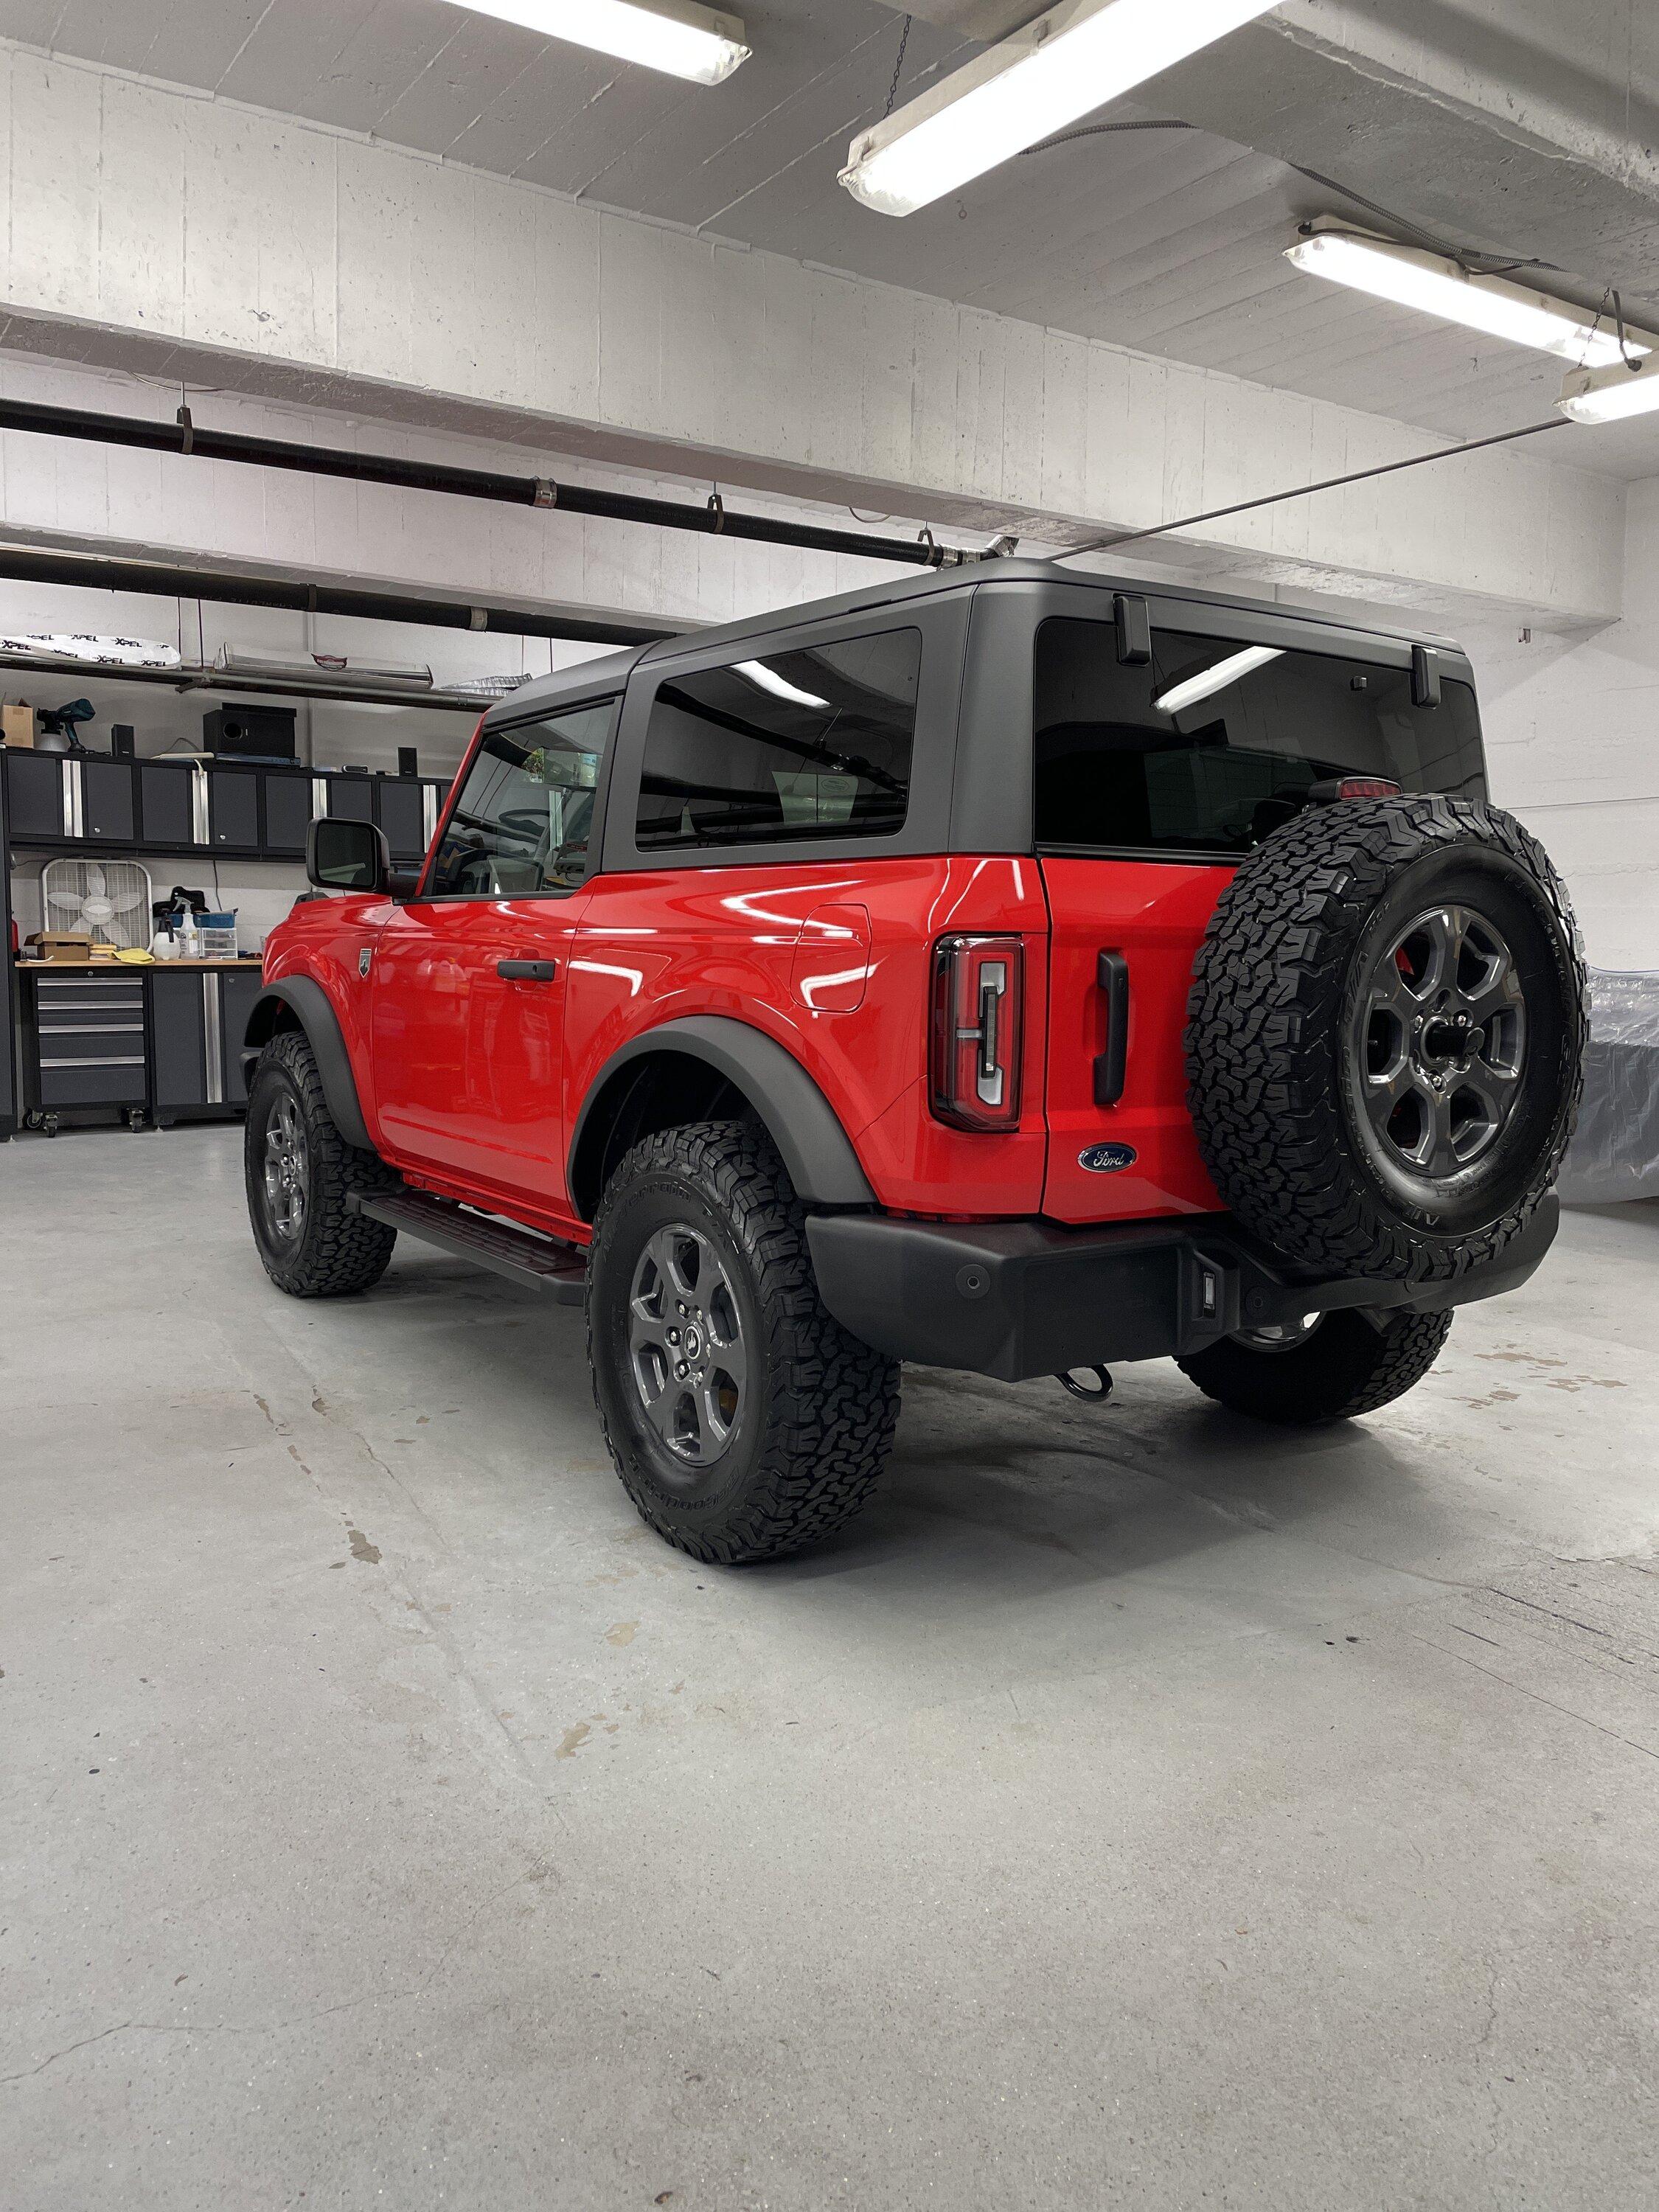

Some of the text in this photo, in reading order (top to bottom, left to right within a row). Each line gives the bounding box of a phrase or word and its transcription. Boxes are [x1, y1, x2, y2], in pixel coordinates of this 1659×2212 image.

[72, 634, 99, 642] XPEL
[115, 637, 142, 647] XPEL
[2, 639, 31, 650] XPEL
[97, 655, 125, 664] XPEL
[1093, 1150, 1125, 1167] Ford
